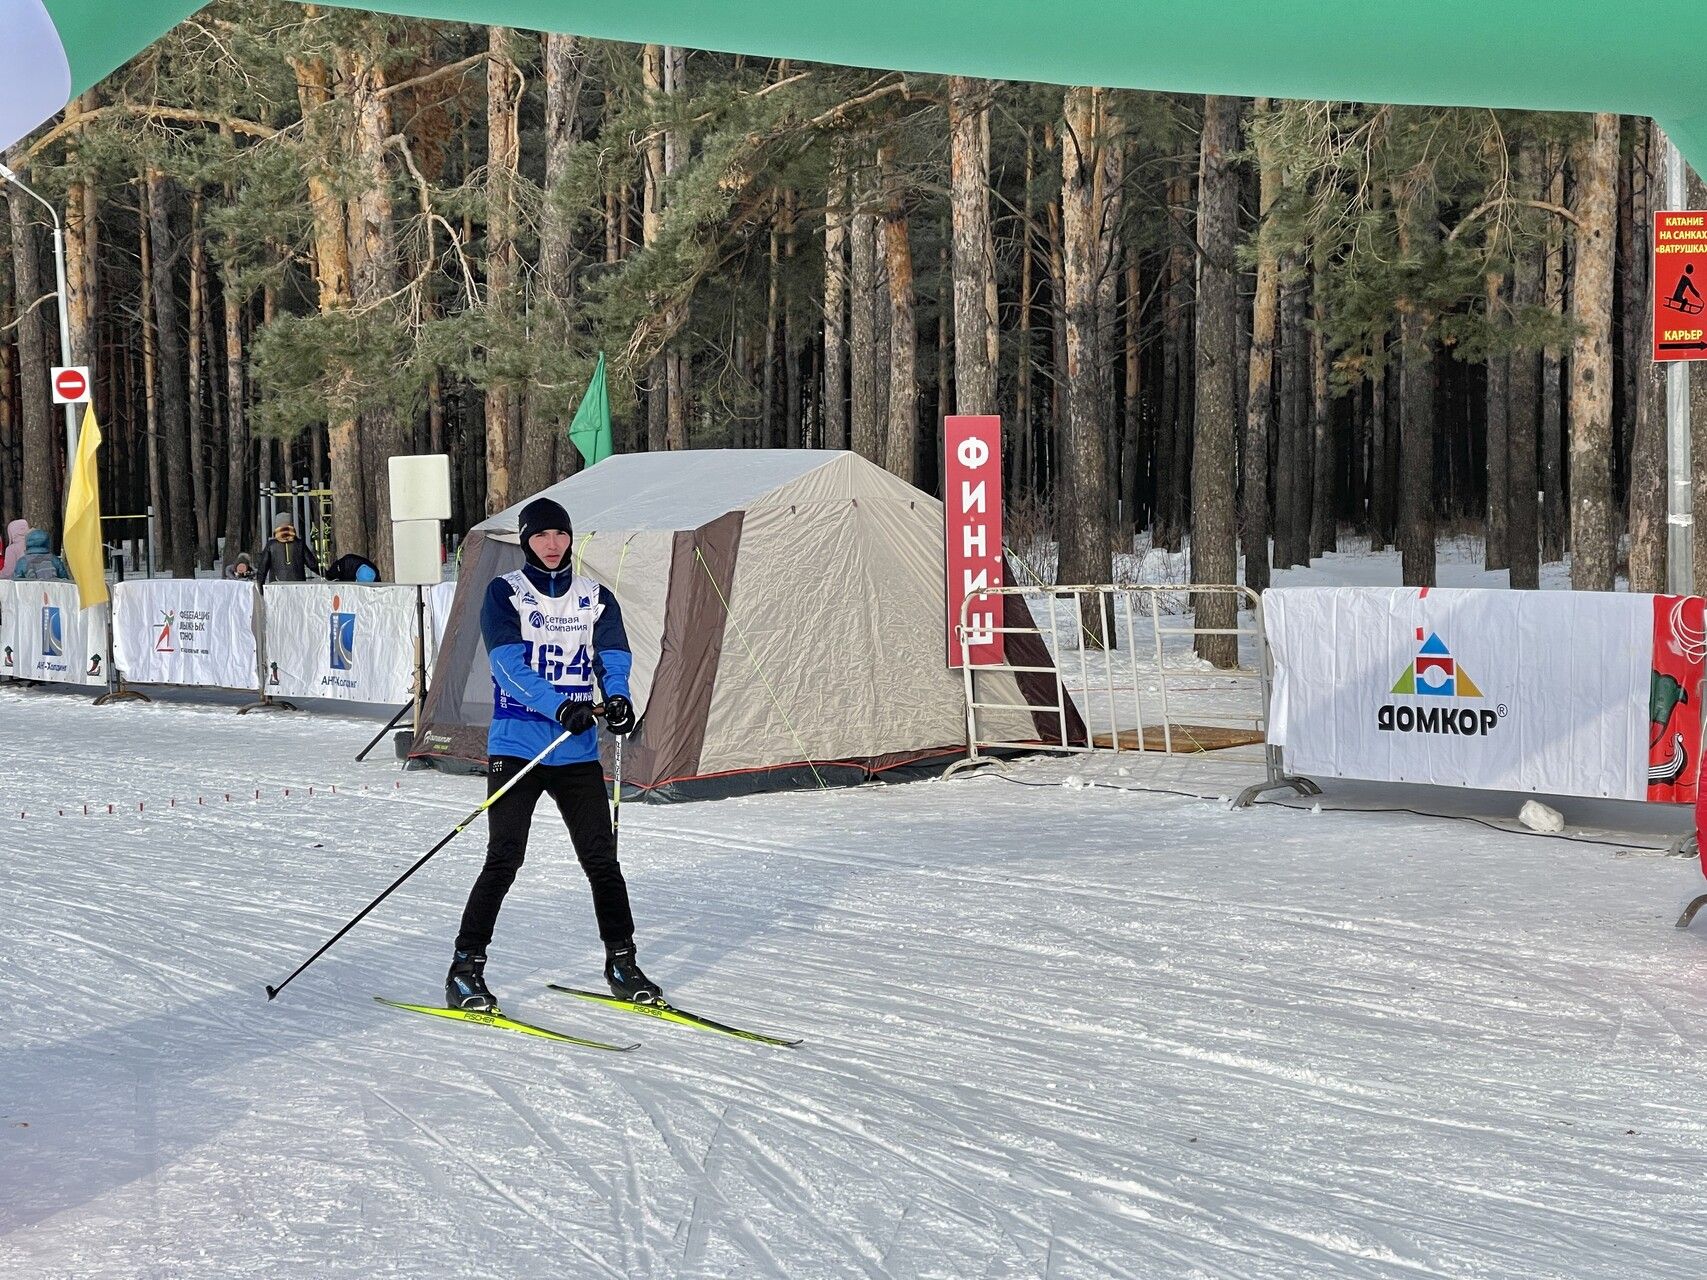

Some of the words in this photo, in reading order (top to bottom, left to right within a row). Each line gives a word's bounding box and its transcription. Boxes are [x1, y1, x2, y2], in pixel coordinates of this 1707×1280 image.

[1665, 217, 1704, 226] КАТАНИЕ
[1659, 230, 1672, 240] НА
[1673, 230, 1707, 240] САНКАХ
[1664, 330, 1703, 341] КАРЬЕР
[957, 436, 994, 646] ФИНИШ
[544, 614, 580, 625] Сетевая
[545, 623, 588, 632] Компания
[1378, 705, 1498, 736] ДОМКОР
[633, 1004, 663, 1017] FISCHER
[463, 1012, 495, 1024] FISCHER
